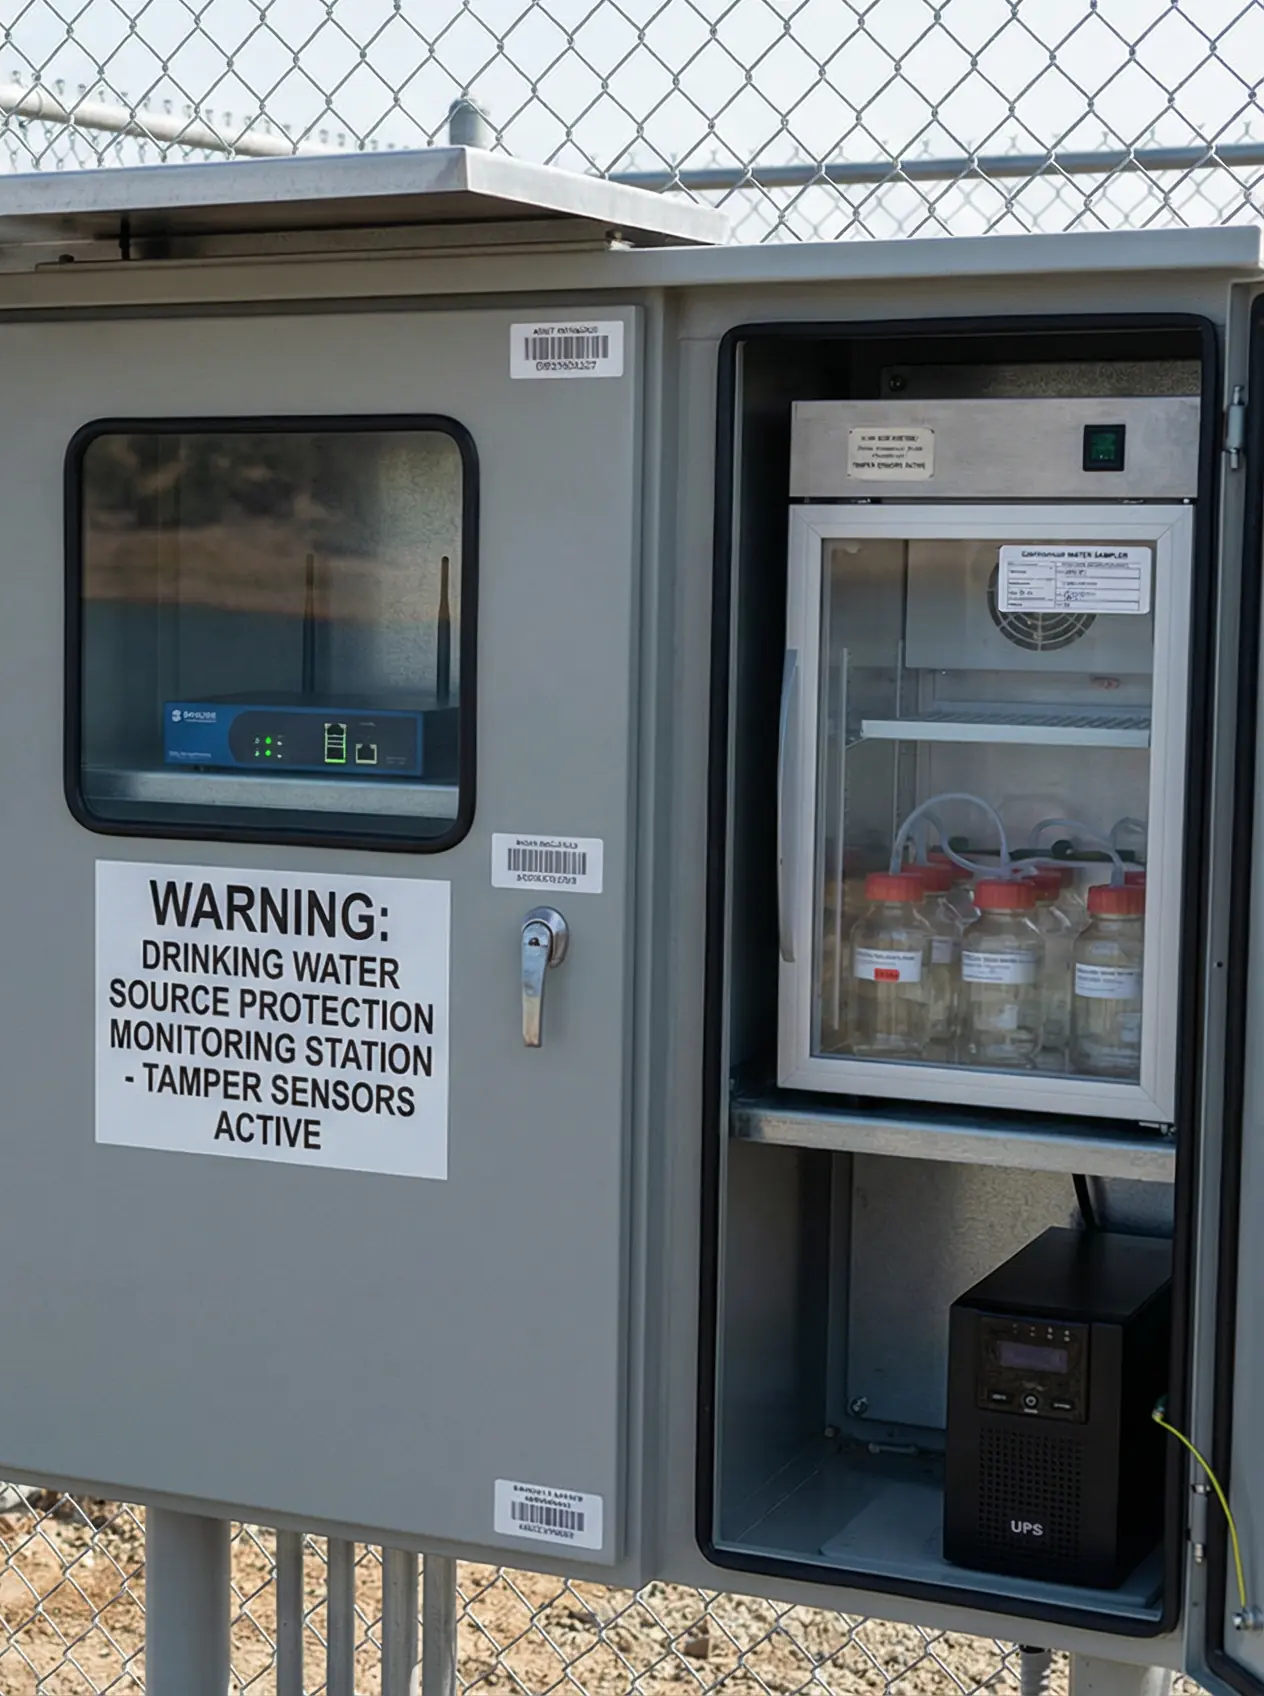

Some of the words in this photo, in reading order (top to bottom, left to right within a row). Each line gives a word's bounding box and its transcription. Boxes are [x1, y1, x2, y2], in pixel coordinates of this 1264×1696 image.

[149, 879, 388, 942] WARNING:
[142, 939, 284, 980] DRINKING
[292, 950, 400, 990] WATER
[109, 978, 230, 1018] SOURCE
[239, 988, 434, 1035] PROTECTION
[110, 1018, 296, 1064] MONITORING
[305, 1035, 432, 1077] STATION
[125, 1075, 134, 1083] -
[142, 1062, 263, 1103] TAMPER
[270, 1074, 415, 1118] SENSORS
[214, 1110, 322, 1150] ACTIVE
[1011, 1520, 1043, 1536] UPS
